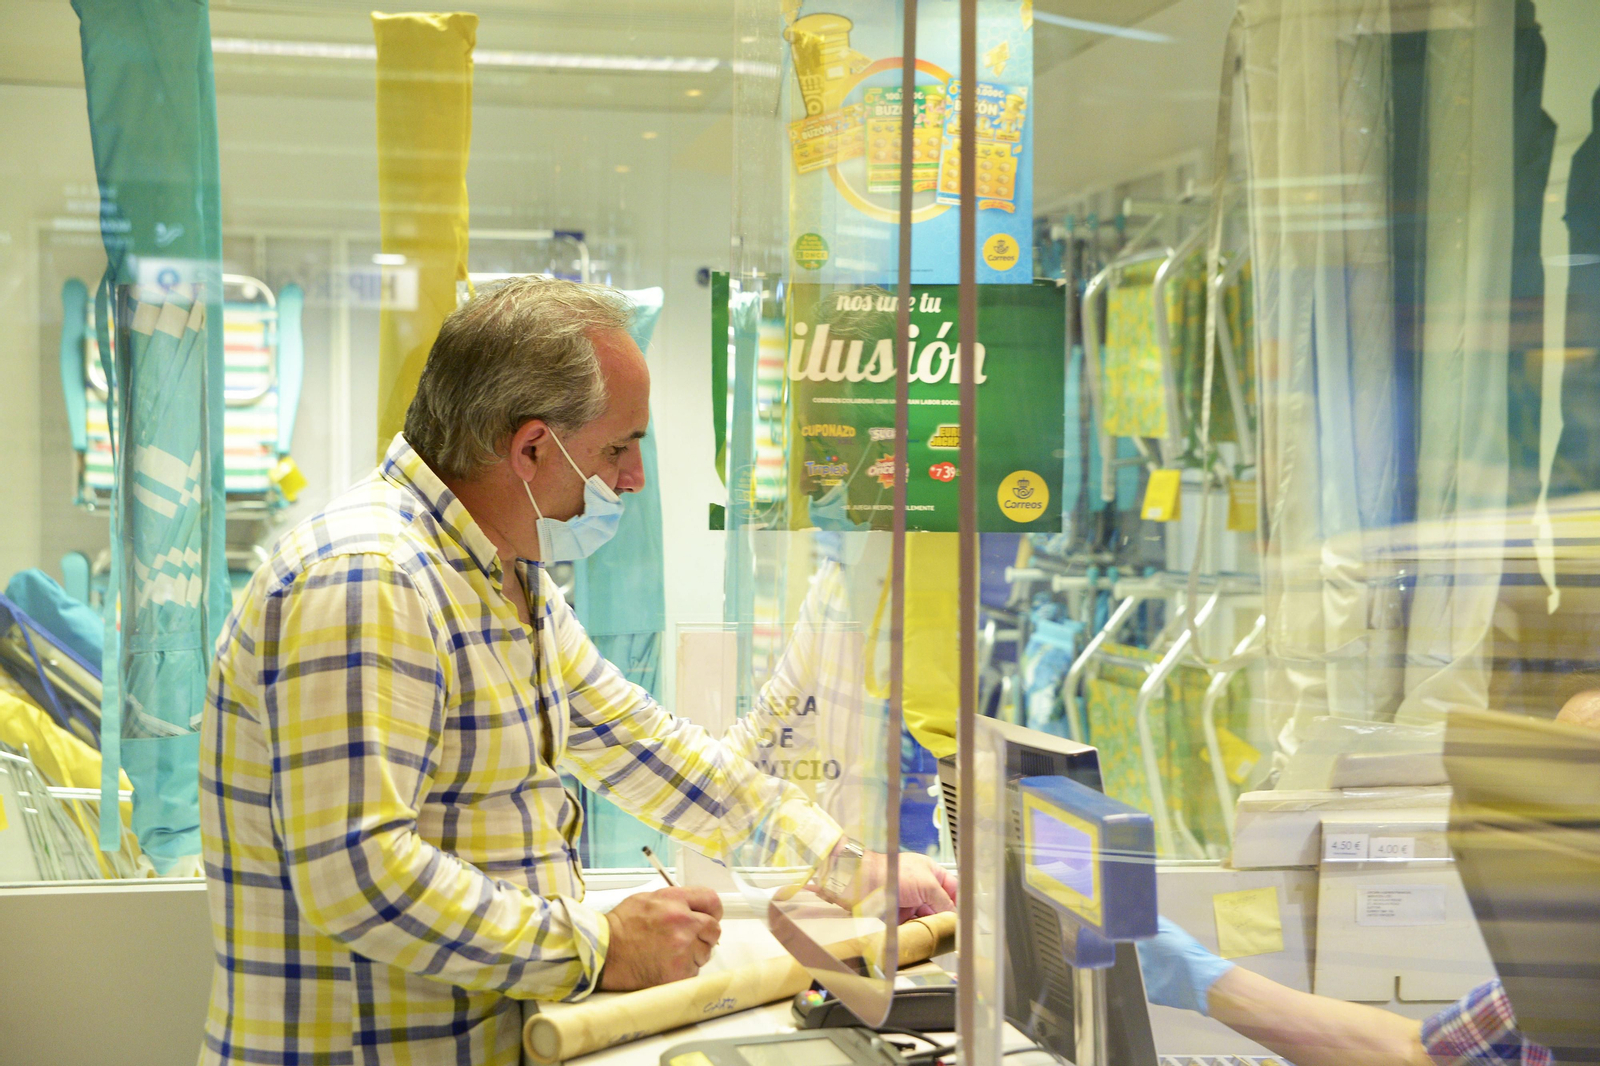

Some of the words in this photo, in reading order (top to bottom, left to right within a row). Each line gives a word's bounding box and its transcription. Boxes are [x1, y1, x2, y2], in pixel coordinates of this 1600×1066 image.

[836, 294, 873, 312] nos
[919, 293, 942, 313] tu
[787, 321, 987, 384] ilusión
[801, 423, 856, 438] CUPONAZO
[804, 459, 850, 477] Triplex
[1004, 499, 1042, 509] Correos
[736, 695, 819, 716] FERA
[759, 727, 793, 748] DE
[1331, 840, 1352, 850] 4.50
[1354, 840, 1361, 850] €
[1377, 844, 1398, 854] 4.00
[1401, 844, 1408, 854] €
